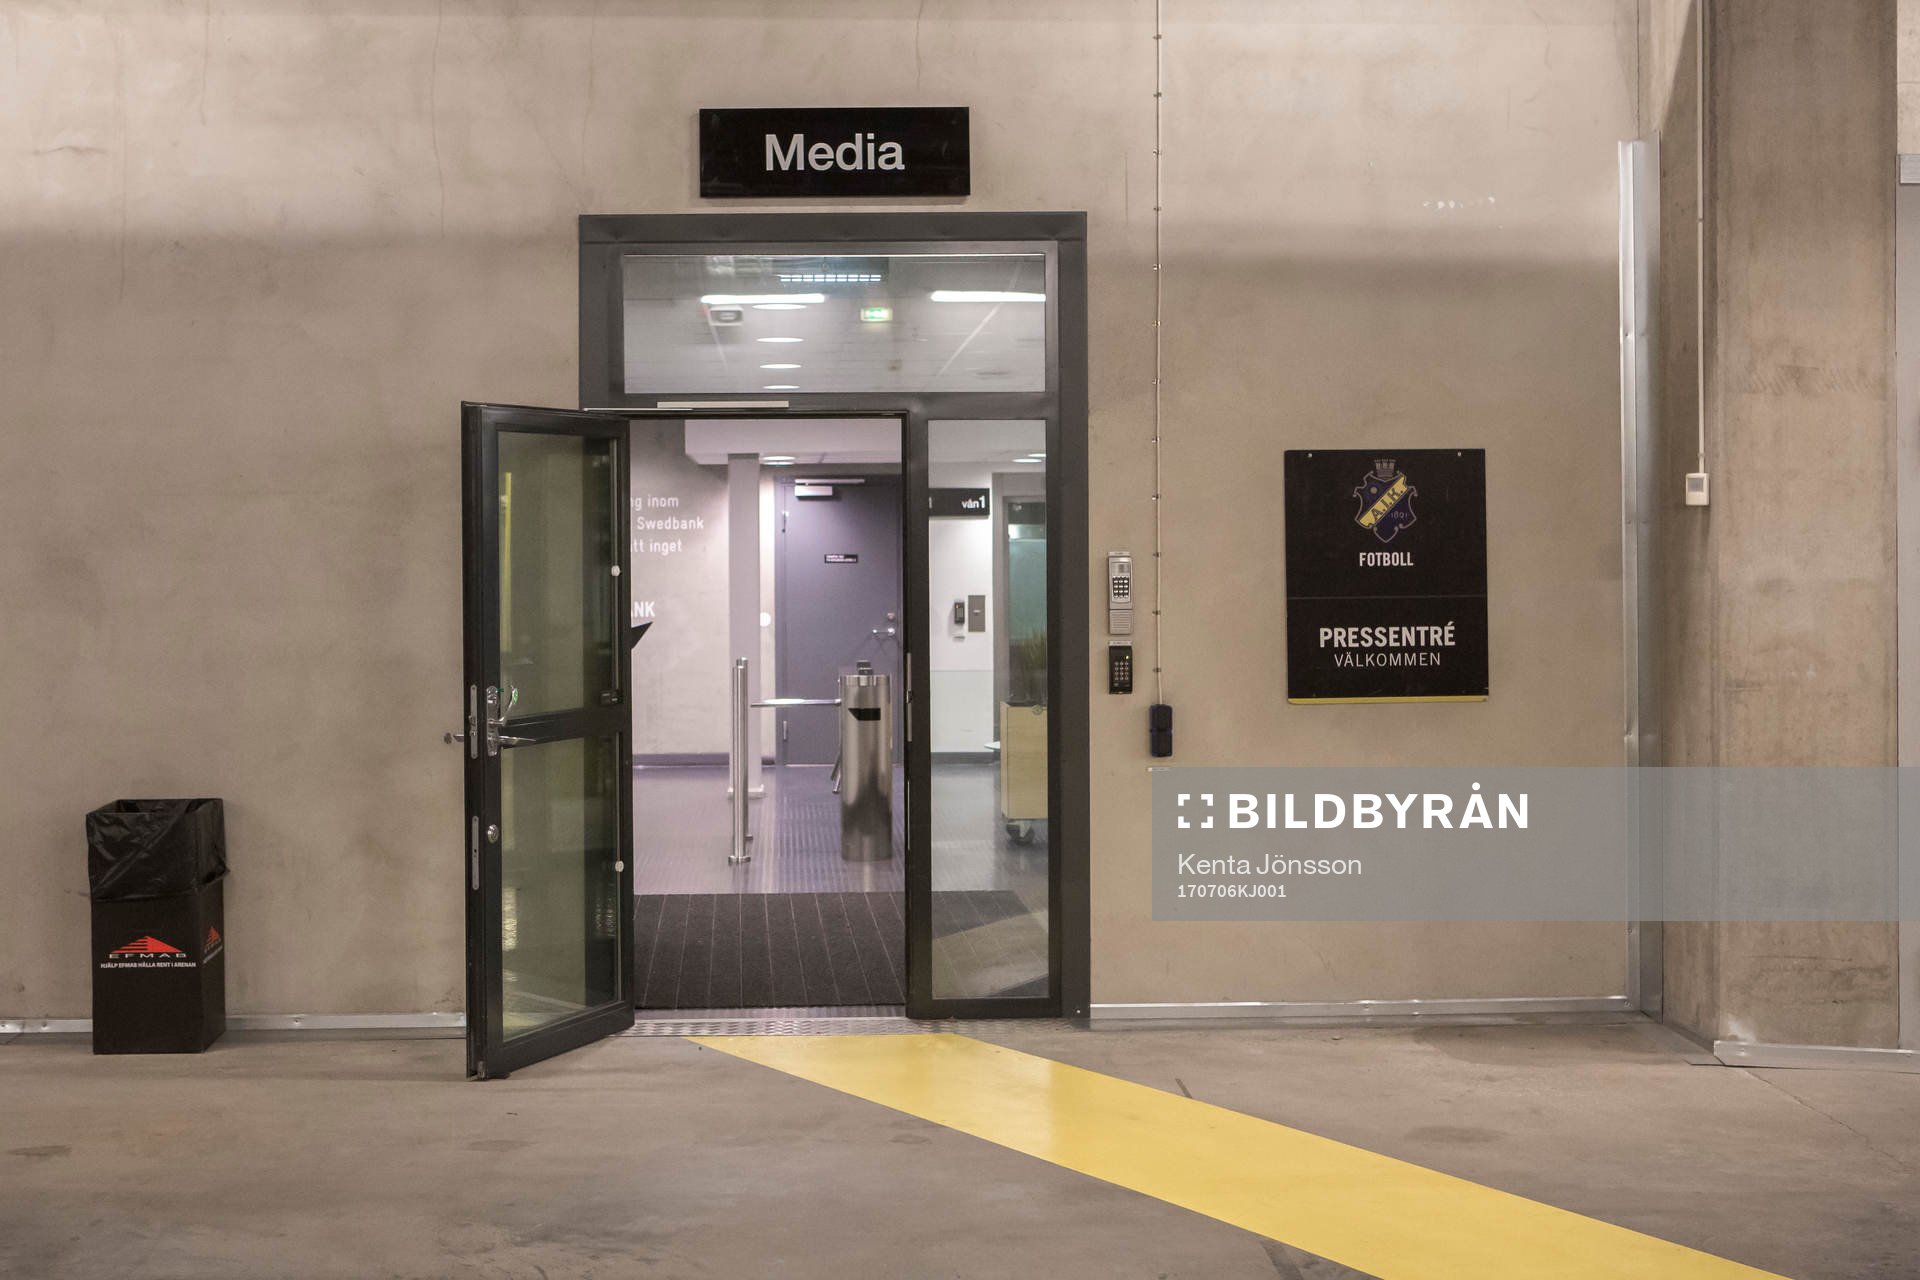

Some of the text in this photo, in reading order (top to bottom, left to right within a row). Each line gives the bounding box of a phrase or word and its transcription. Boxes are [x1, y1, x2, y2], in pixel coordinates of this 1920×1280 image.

[766, 133, 905, 171] Media
[647, 494, 679, 508] inom
[637, 516, 704, 530] Swedbank
[649, 539, 682, 556] inget
[1359, 551, 1414, 567] FOTBOLL
[1319, 620, 1456, 648] PRESSENTRÉ
[1334, 651, 1441, 668] VÄLKOMMEN
